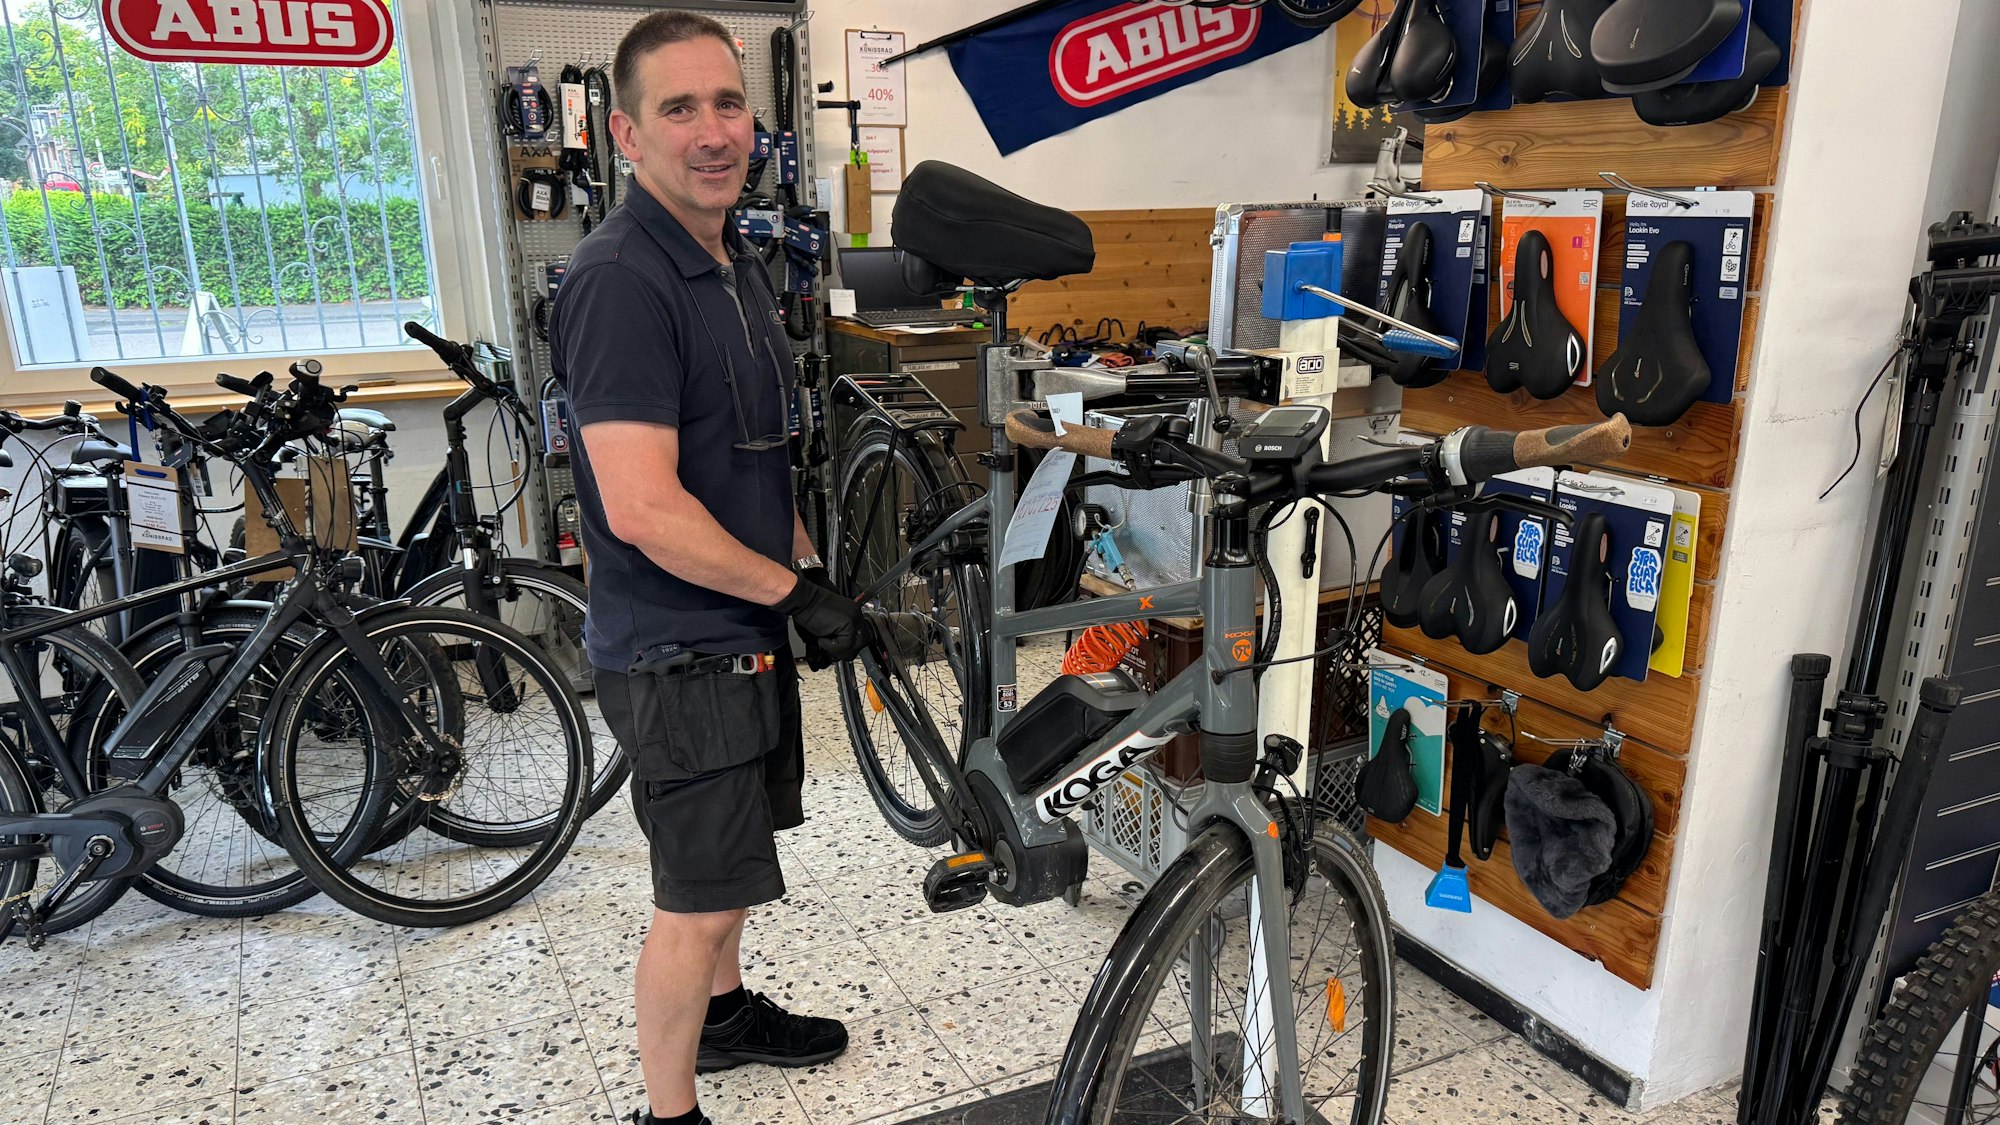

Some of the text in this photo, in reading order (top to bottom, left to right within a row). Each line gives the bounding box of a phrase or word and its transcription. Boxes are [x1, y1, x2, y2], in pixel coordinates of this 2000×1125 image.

[150, 0, 356, 47] ABUS
[1085, 5, 1236, 85] ABUS
[867, 88, 894, 102] 40%
[520, 146, 553, 158] AXA
[1391, 199, 1421, 208] Selle Royal
[1631, 200, 1669, 210] Selle Royal
[1559, 501, 1577, 512] Lookin
[1521, 521, 1541, 540] STRA
[1516, 549, 1537, 566] ELLA
[1634, 548, 1658, 567] STRA
[1629, 578, 1655, 596] ELLA
[1223, 630, 1256, 639] KOGA
[1044, 745, 1159, 817] KOGA
[1352, 850, 1365, 868] PLUS
